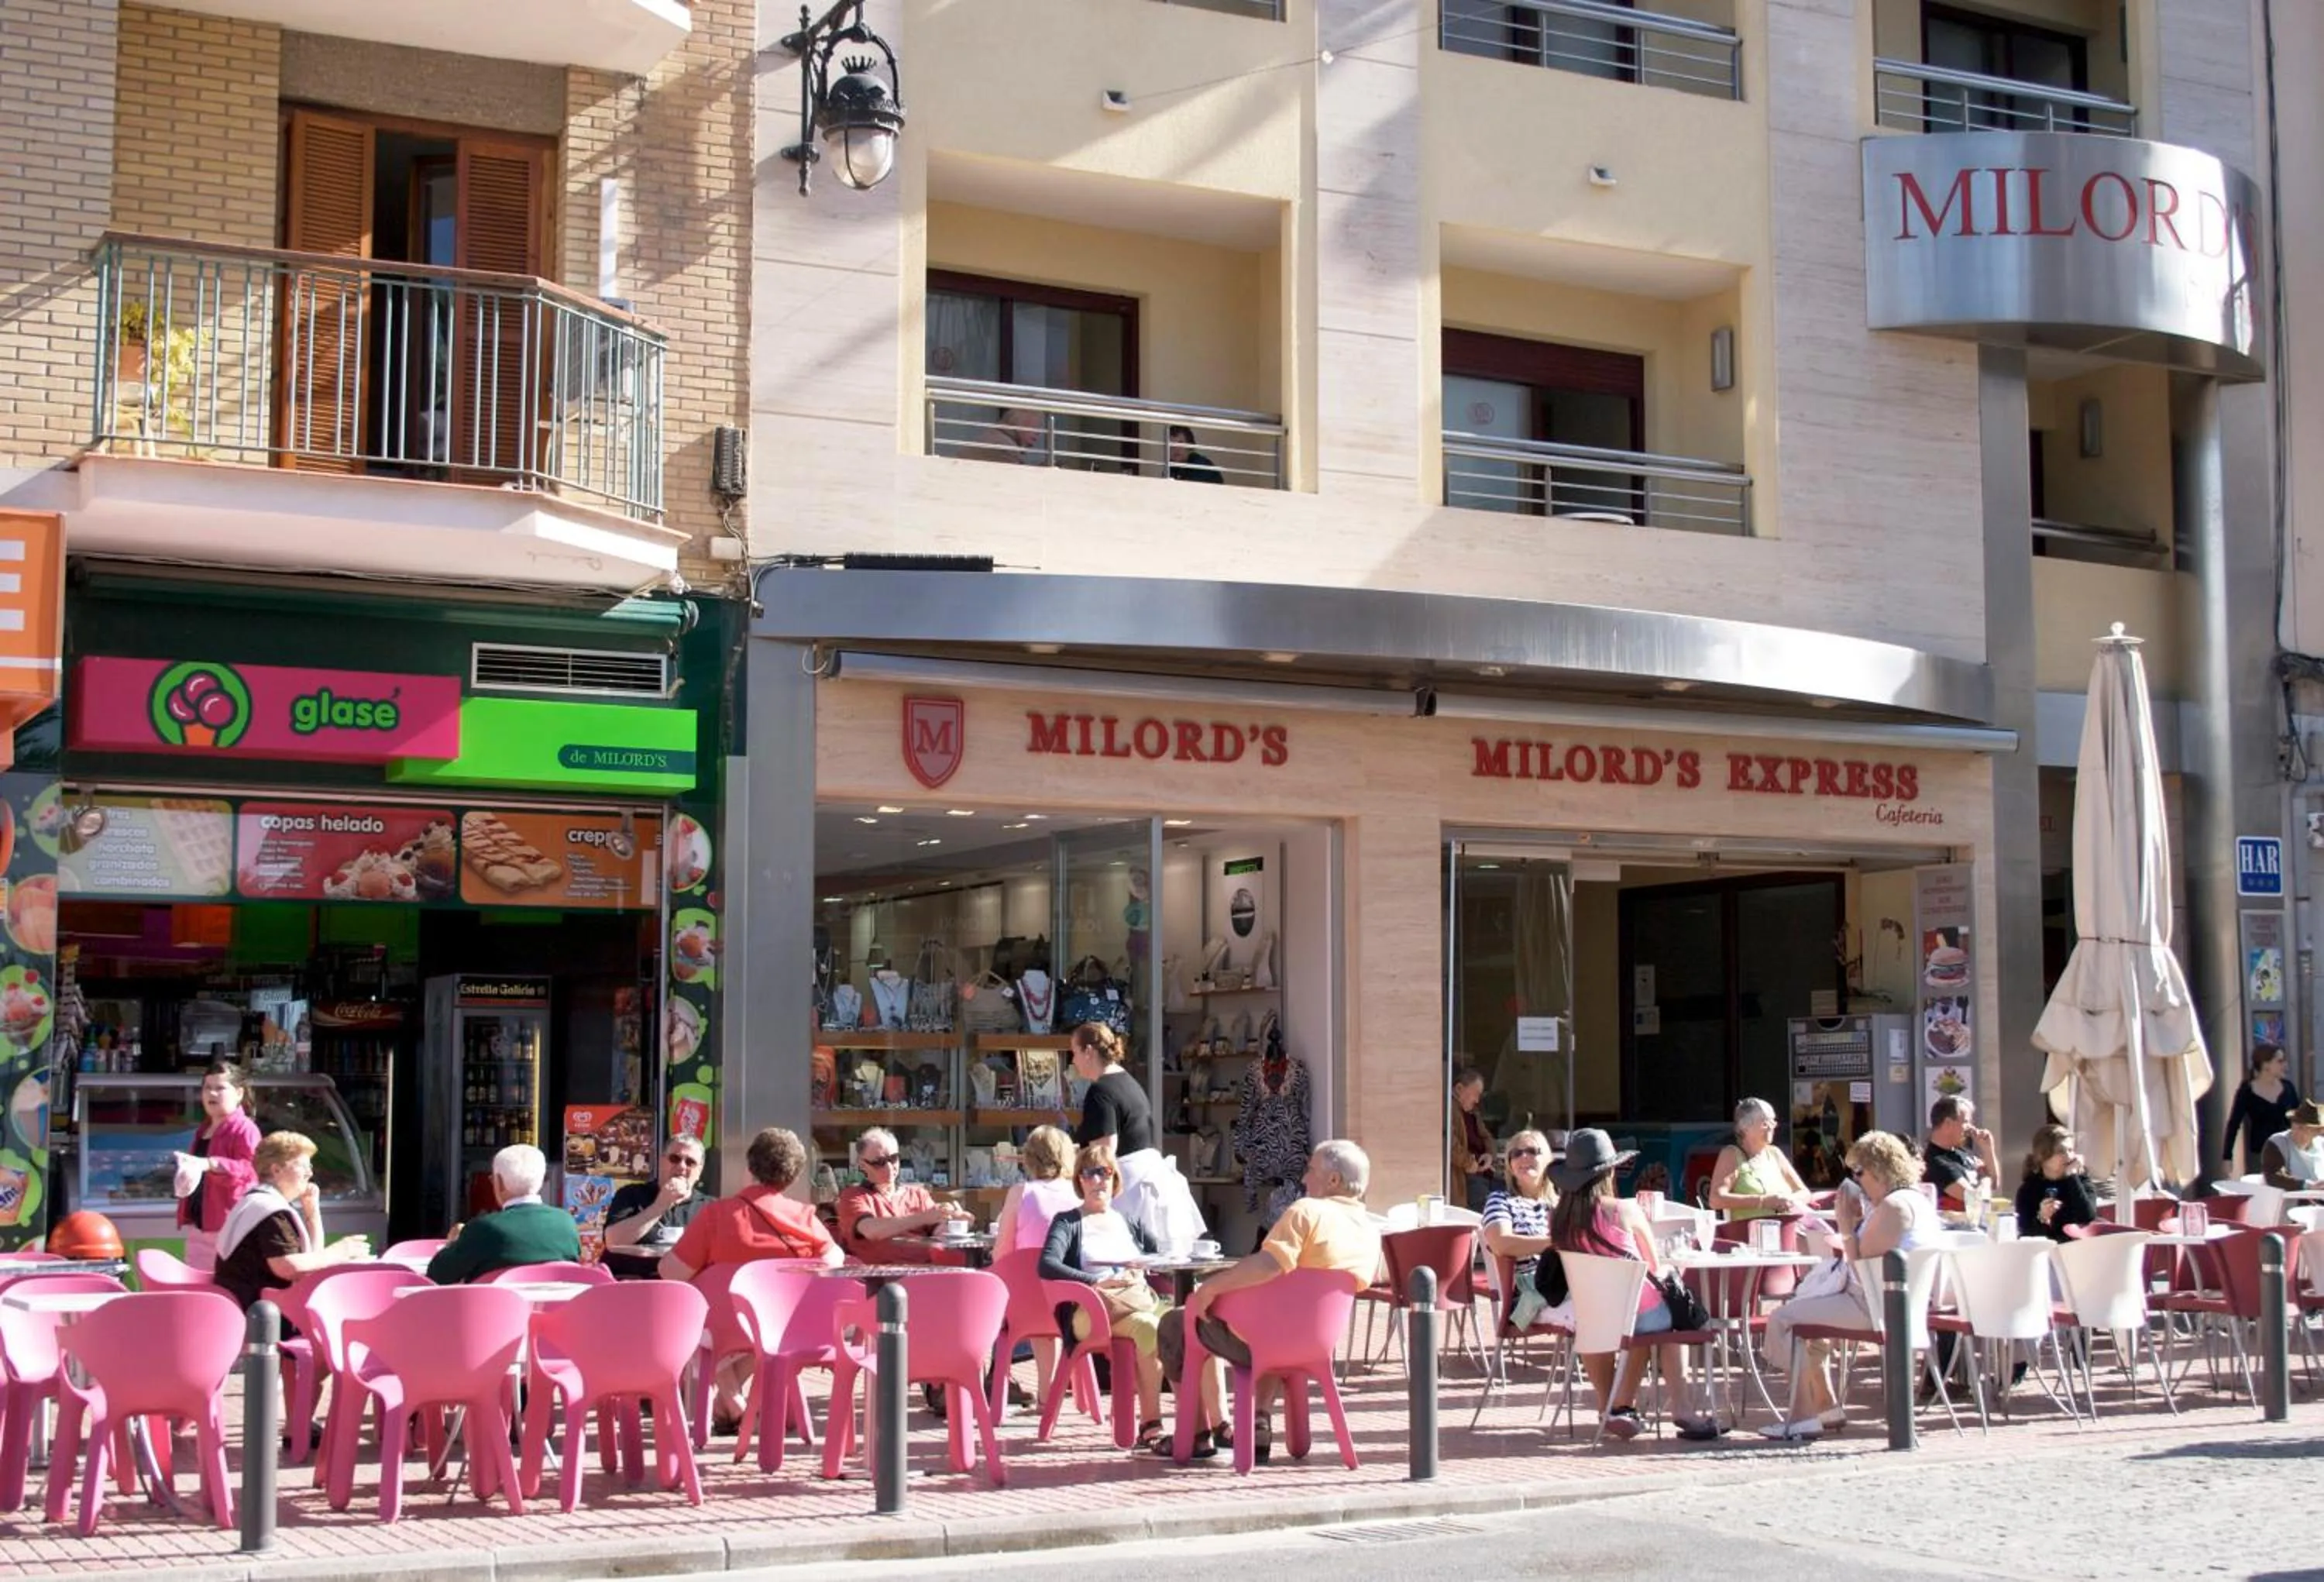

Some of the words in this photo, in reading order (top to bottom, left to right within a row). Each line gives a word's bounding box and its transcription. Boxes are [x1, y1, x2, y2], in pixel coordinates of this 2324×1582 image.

[915, 719, 953, 755] M
[1026, 711, 1289, 766] MILORD'S
[569, 750, 587, 763] de
[593, 751, 668, 768] MILORD'S
[1471, 738, 1702, 789] MILORD'S
[1726, 753, 1920, 800] EXPRESS
[260, 814, 315, 832] copas
[321, 814, 384, 833] helado
[1875, 803, 1943, 827] Cafeteria
[2240, 844, 2279, 874] HAR
